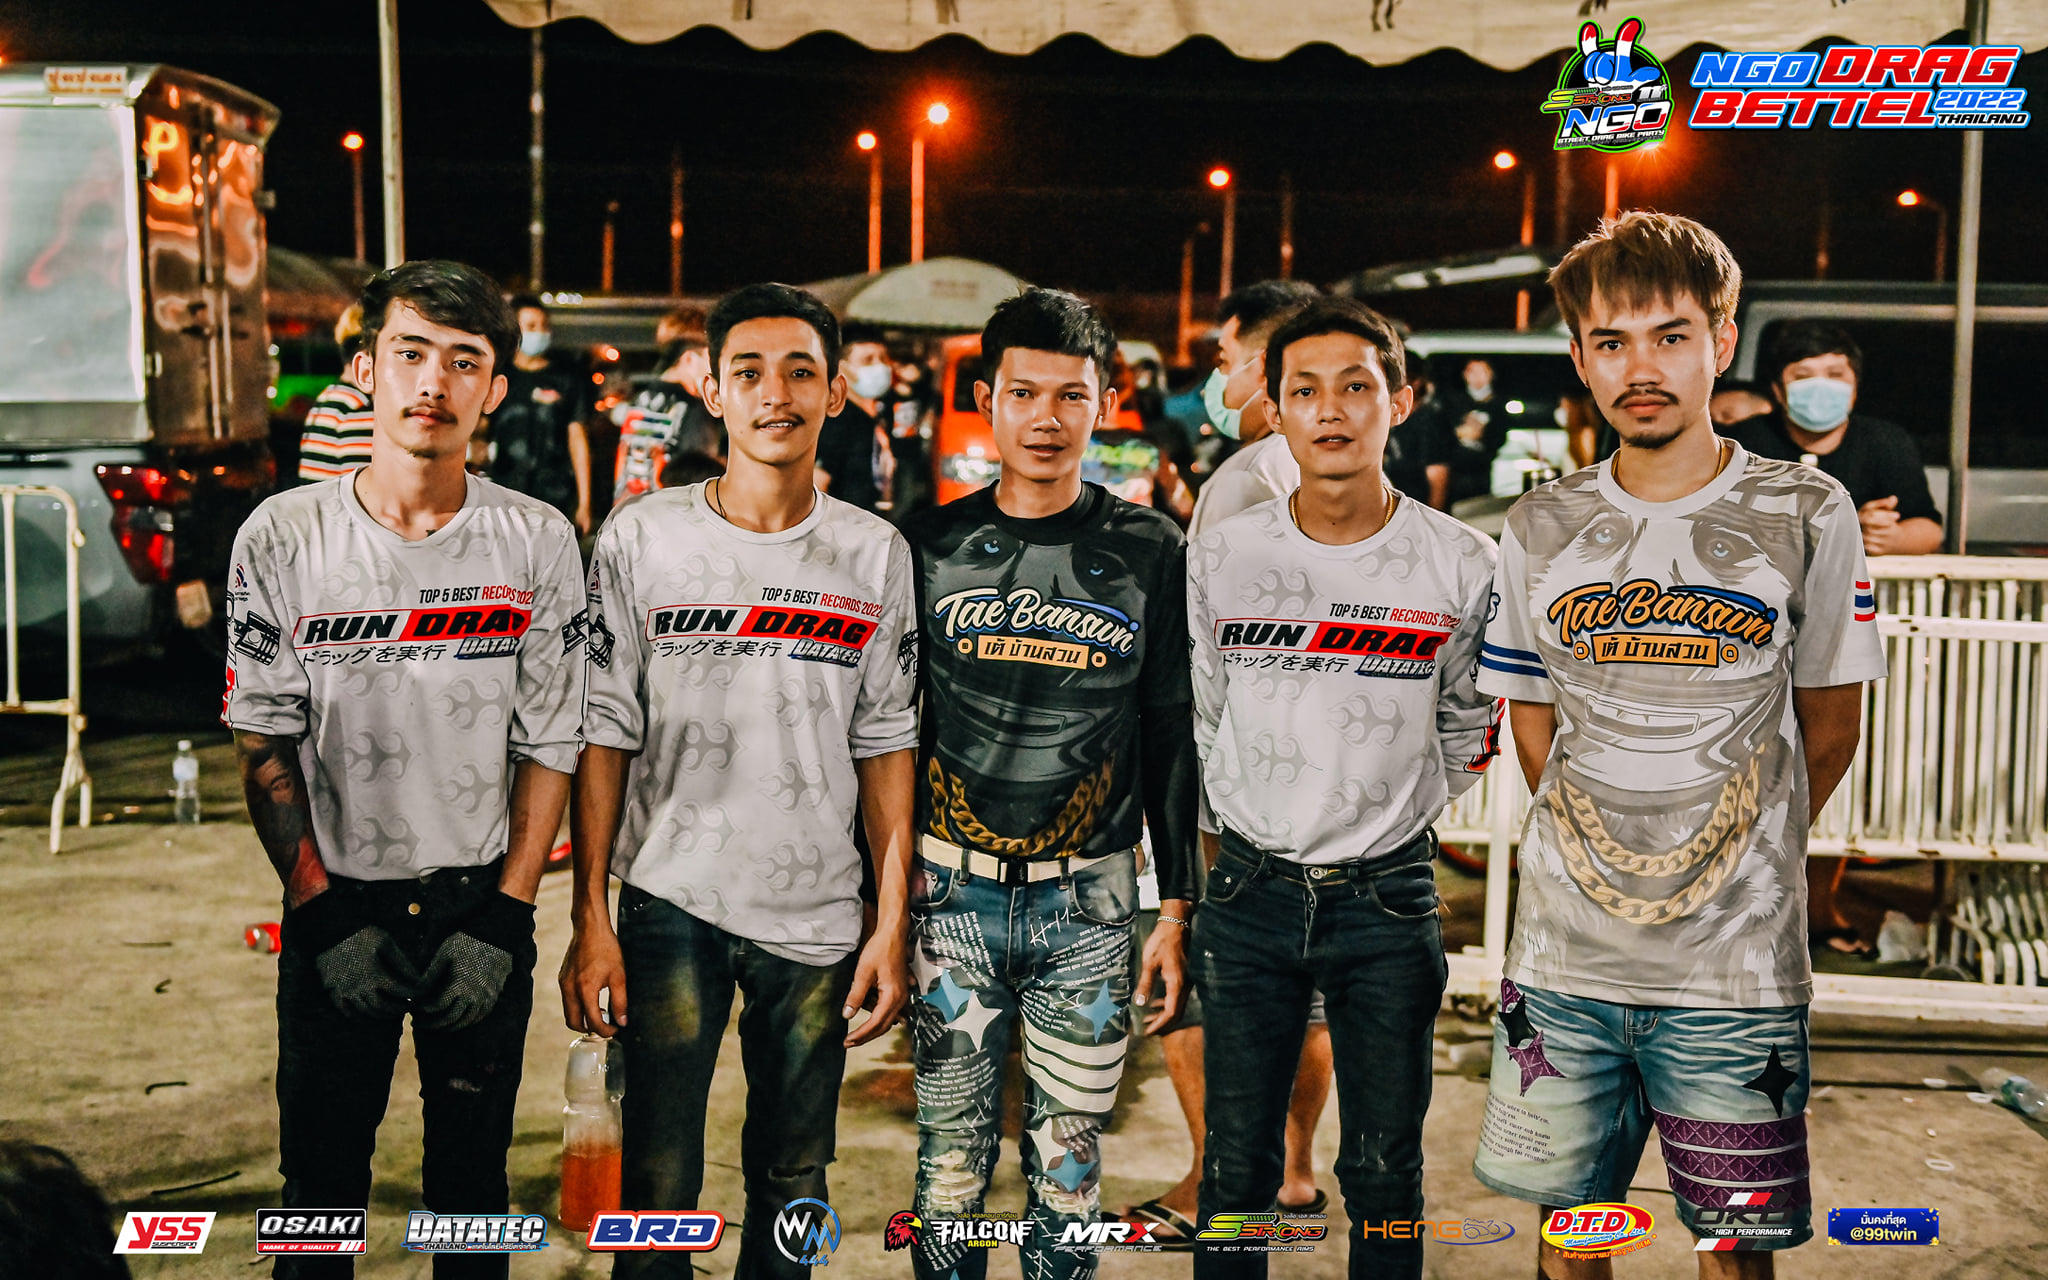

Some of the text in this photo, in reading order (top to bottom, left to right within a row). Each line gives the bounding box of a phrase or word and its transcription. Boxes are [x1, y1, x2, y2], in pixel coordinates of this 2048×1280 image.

[420, 589, 440, 604] TOP
[442, 588, 450, 603] 5
[452, 586, 480, 602] BEST
[762, 587, 782, 602] TOP
[783, 589, 792, 602] 5
[792, 590, 820, 605] BEST
[820, 593, 861, 613] RECORDS
[936, 588, 1006, 637] Tae
[1329, 603, 1350, 618] TOP
[1351, 604, 1360, 619] 5
[1360, 605, 1390, 620] BEST
[1390, 608, 1440, 626] RECORDS
[1549, 584, 1619, 644] Tae
[303, 614, 399, 645] RUN
[655, 609, 868, 645] RUN DRAG
[1220, 623, 1308, 647] RUN
[1009, 639, 1082, 664] บ้านสวน
[1623, 636, 1710, 660] บ้านสวน
